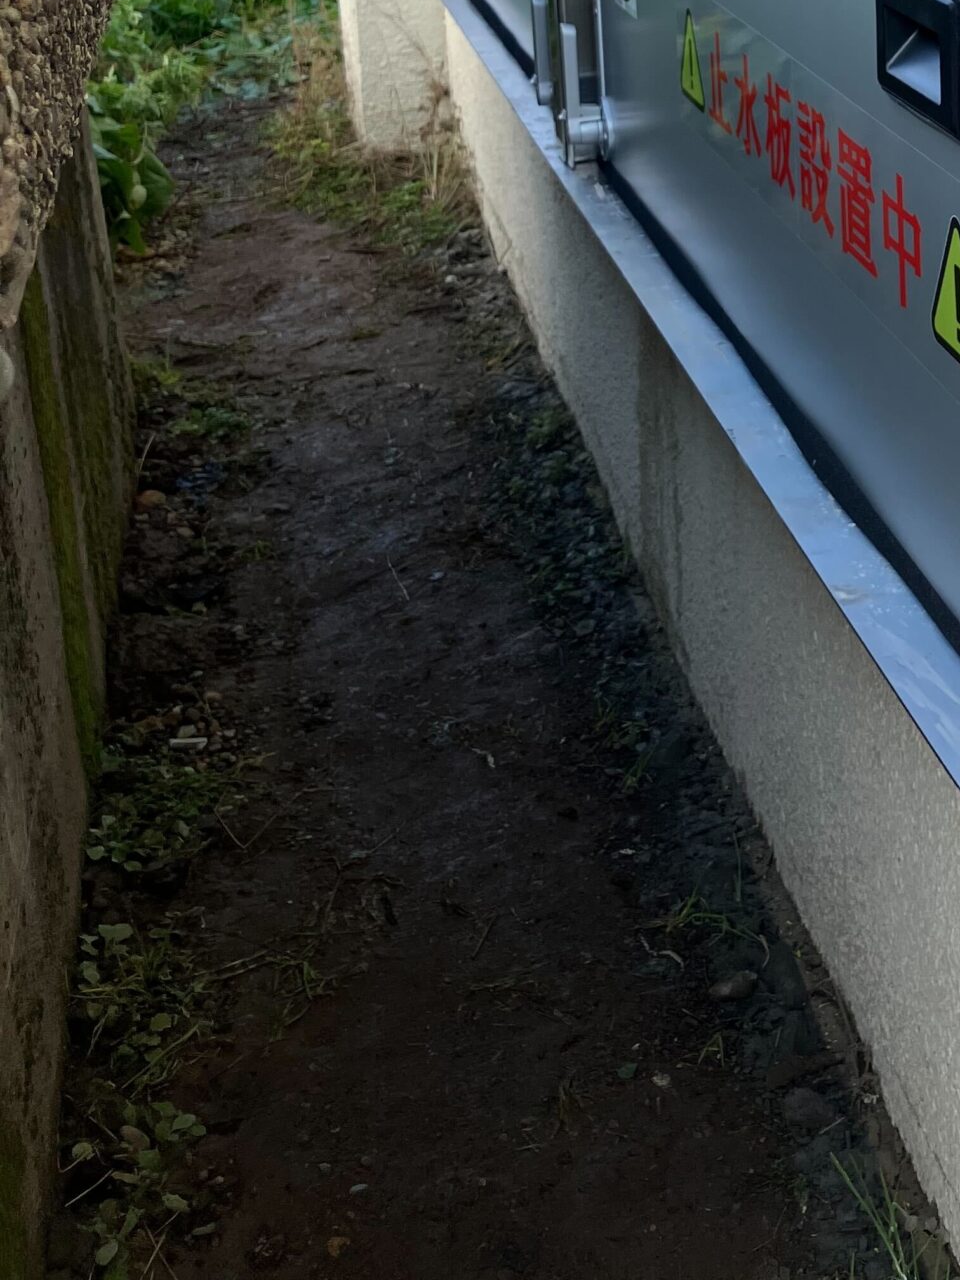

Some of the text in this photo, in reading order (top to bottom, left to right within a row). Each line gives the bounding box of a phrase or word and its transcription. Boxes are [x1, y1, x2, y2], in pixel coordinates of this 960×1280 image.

[708, 32, 922, 308] 止水板設置中
